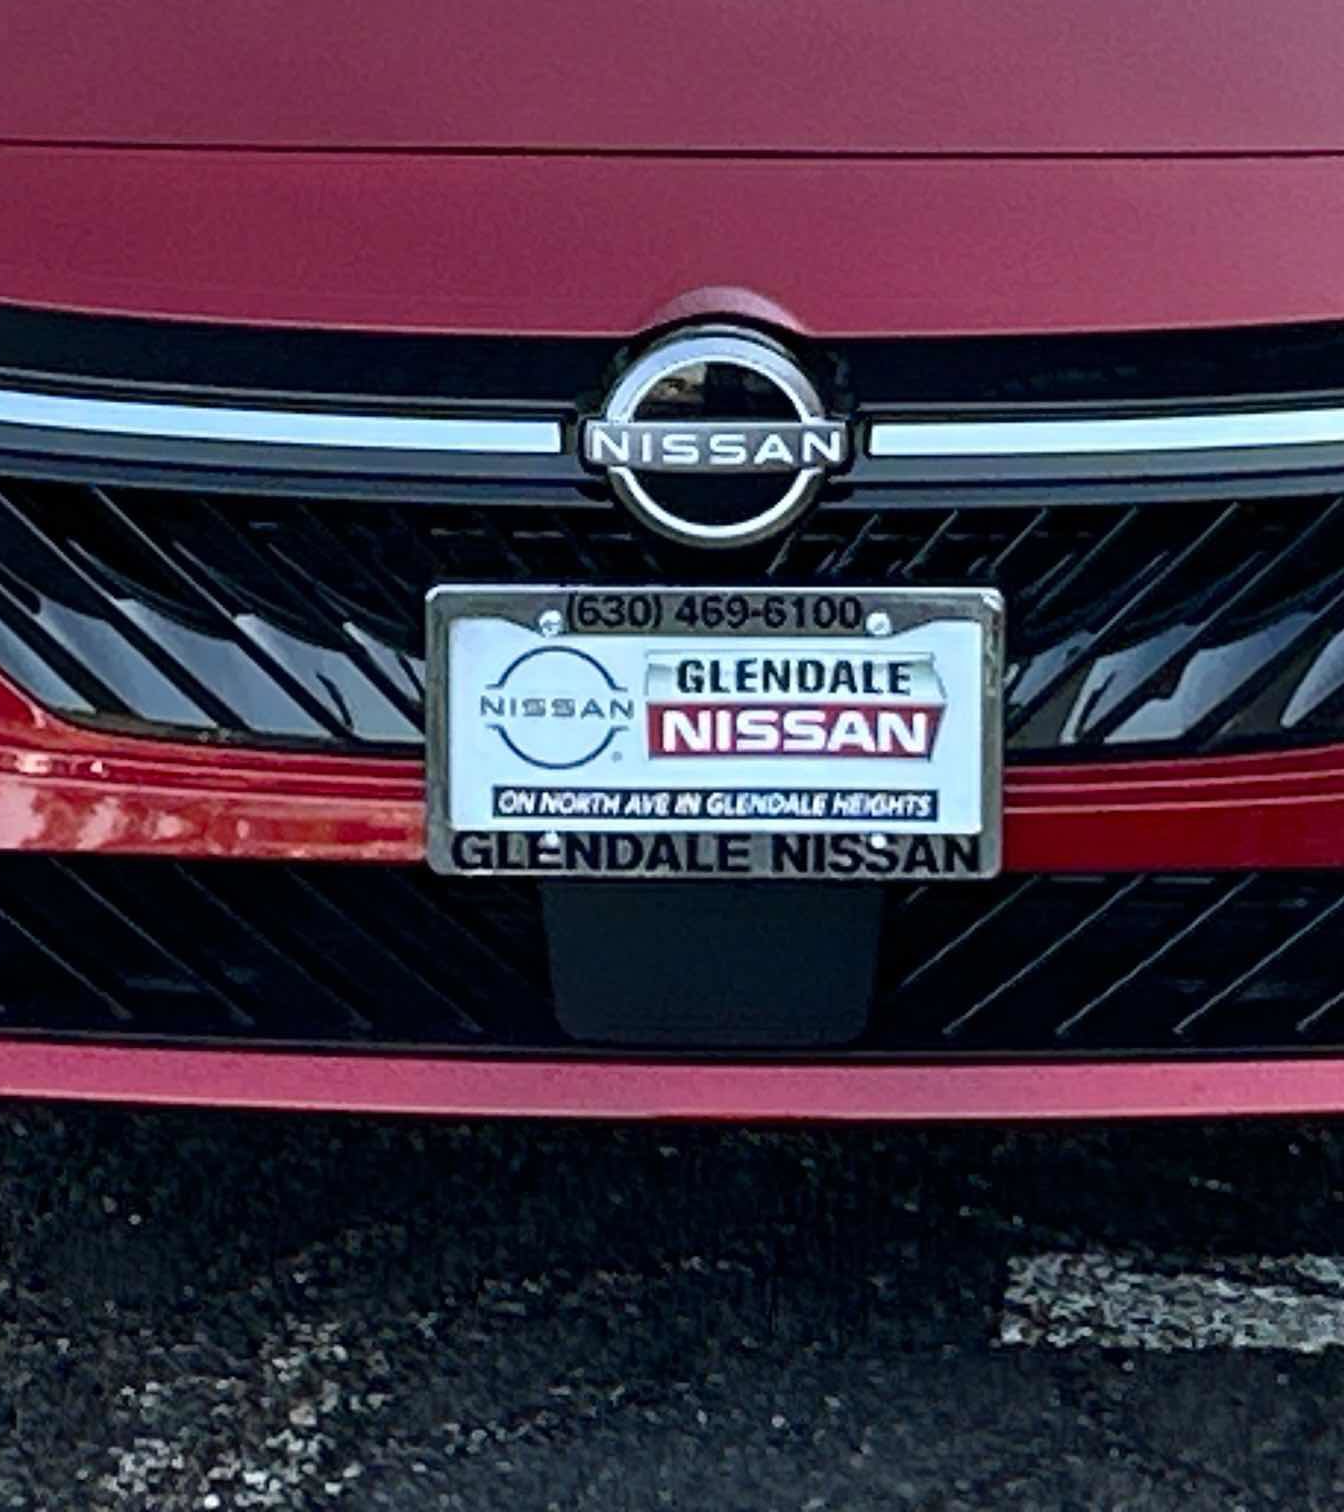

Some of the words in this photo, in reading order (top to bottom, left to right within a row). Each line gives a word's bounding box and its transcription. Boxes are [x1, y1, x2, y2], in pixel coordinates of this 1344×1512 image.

[591, 430, 843, 465] NISSAN
[566, 593, 663, 633] (630)
[674, 594, 863, 630] 469-6100
[675, 657, 913, 696] GLENDALE
[479, 695, 635, 720] NISSAN
[661, 709, 929, 754] NISSAN
[497, 789, 537, 815] ON
[538, 791, 620, 816] NORTH
[623, 792, 671, 816] AVE
[673, 792, 702, 817] IN
[705, 791, 829, 818] GLENDALE
[830, 791, 933, 819] HEIGHTS
[451, 831, 752, 873] GLENDALE
[771, 832, 981, 875] NISSAN
